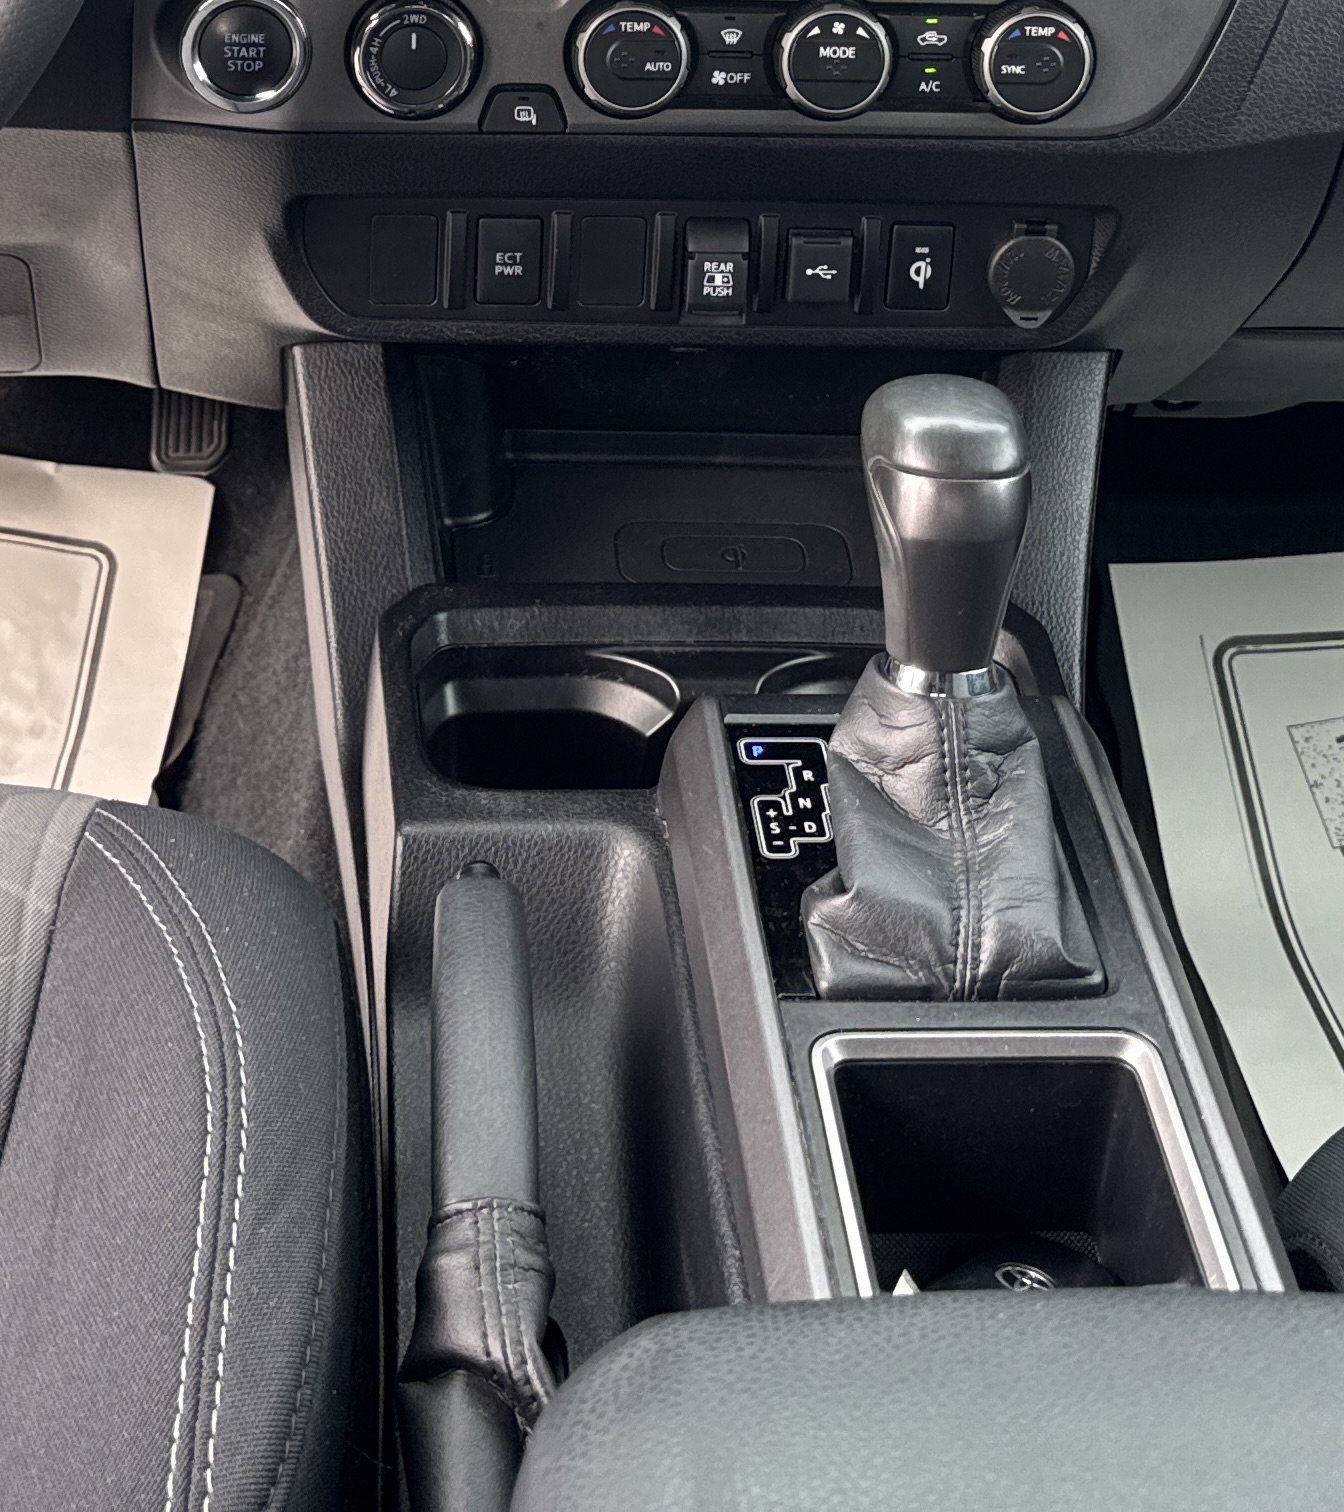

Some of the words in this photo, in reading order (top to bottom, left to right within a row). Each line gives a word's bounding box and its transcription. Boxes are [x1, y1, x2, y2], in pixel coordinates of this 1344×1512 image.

[402, 14, 427, 25] 2WD
[619, 21, 651, 33] TEMP
[1024, 26, 1056, 38] TEMP
[224, 33, 265, 45] ENGINE
[223, 46, 266, 59] START
[819, 46, 856, 59] MODE
[227, 60, 264, 72] STOP
[644, 62, 672, 72] AUTO
[1001, 65, 1026, 75] SYNC
[727, 72, 752, 84] OFF
[919, 80, 941, 92] A/C
[495, 252, 523, 264] ECT
[494, 264, 523, 276] PWR
[703, 262, 734, 274] REAR
[702, 286, 733, 298] PUSH
[752, 745, 764, 757] P
[802, 770, 815, 782] R
[798, 798, 812, 809] N
[769, 822, 781, 834] S
[803, 821, 817, 833] D
